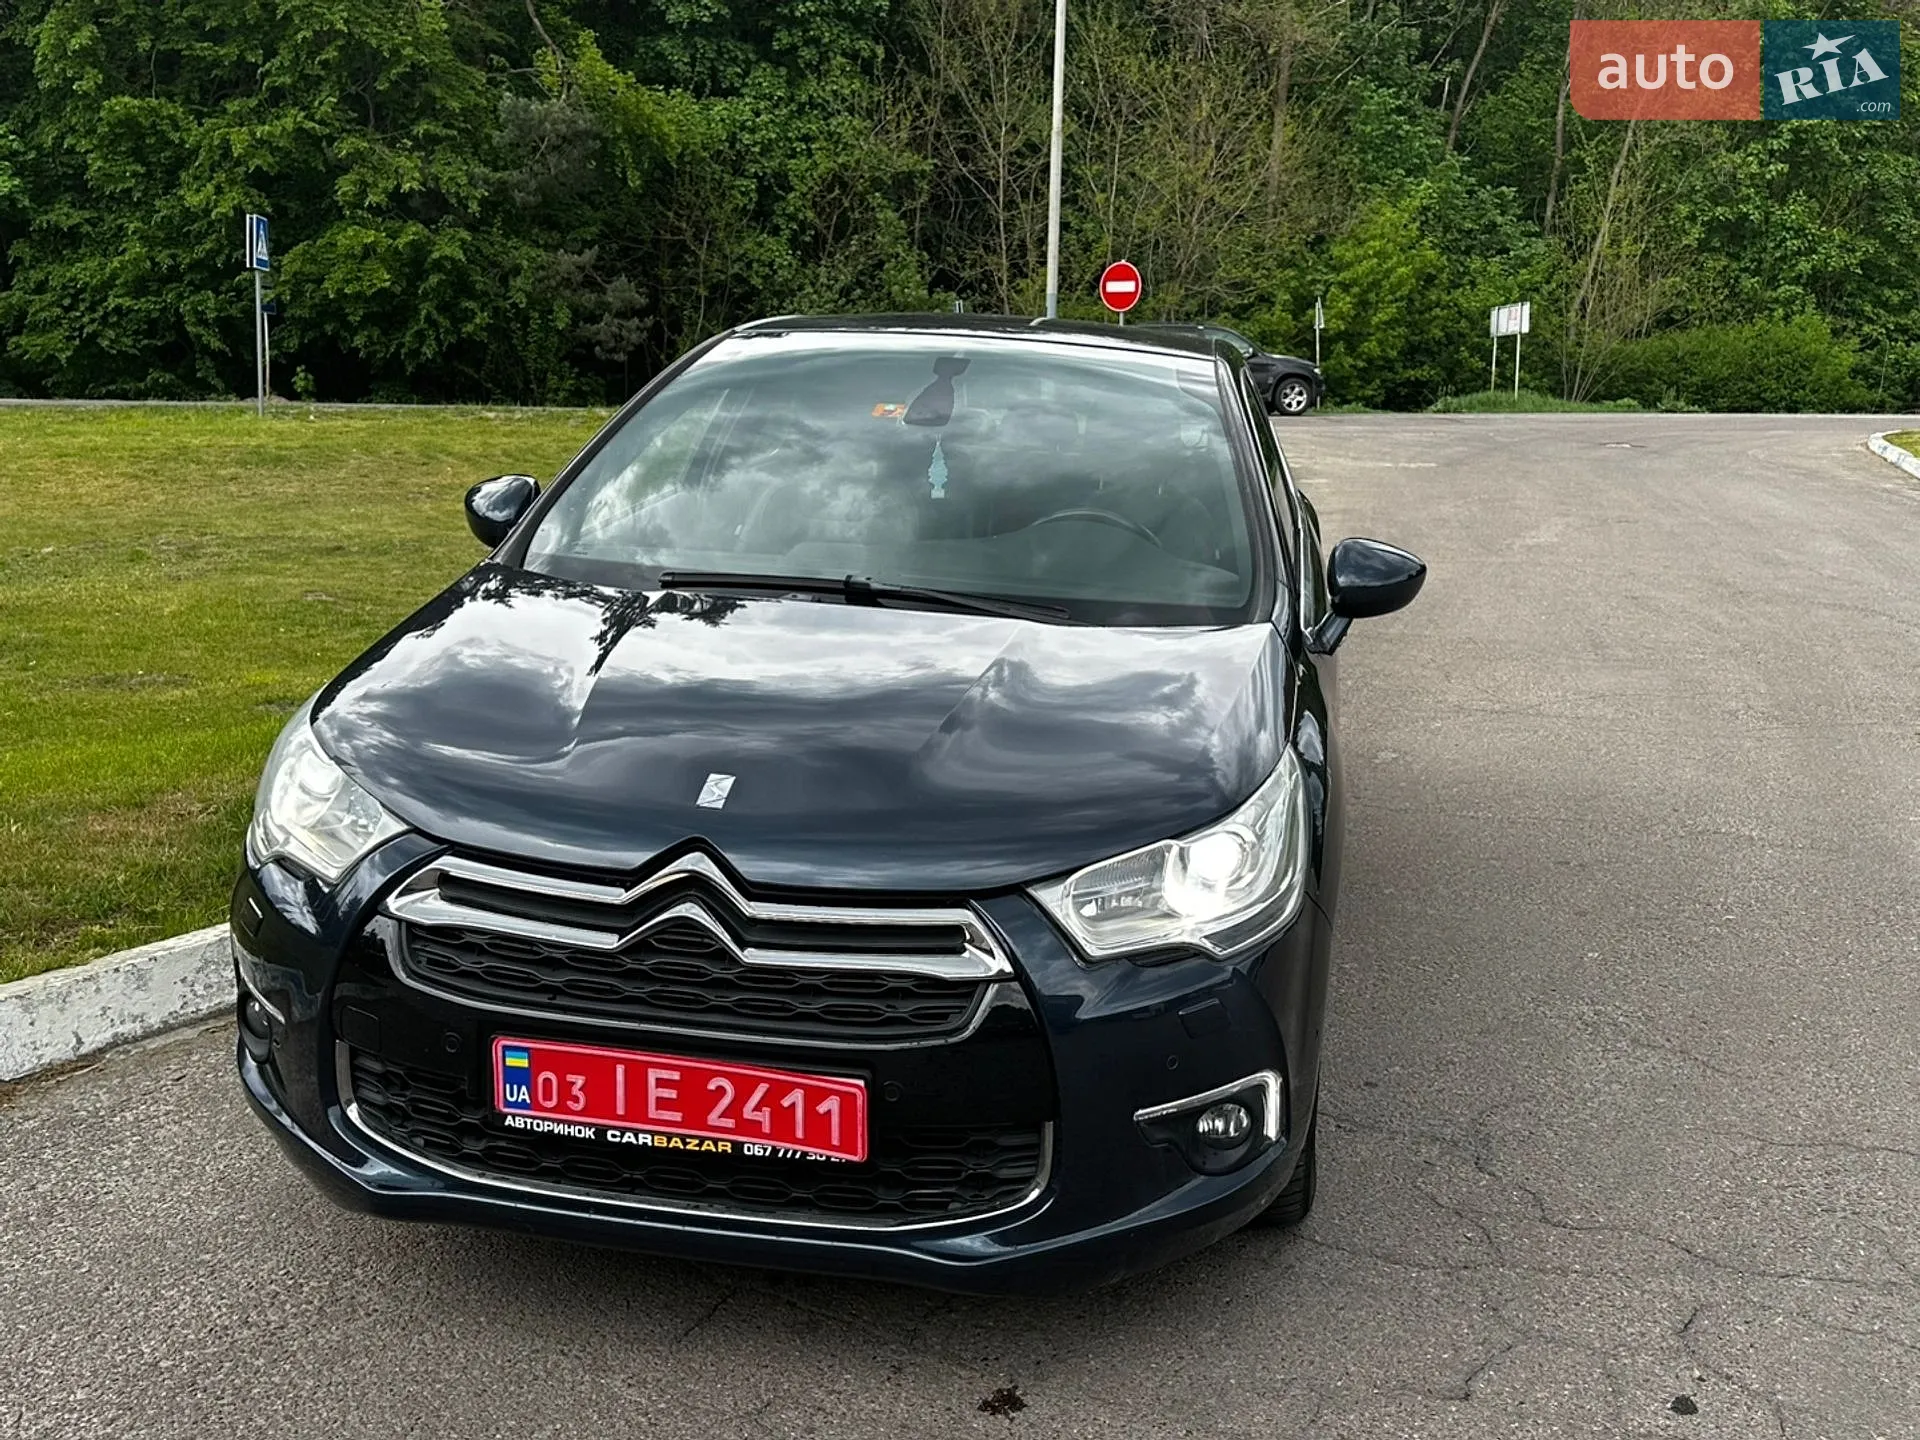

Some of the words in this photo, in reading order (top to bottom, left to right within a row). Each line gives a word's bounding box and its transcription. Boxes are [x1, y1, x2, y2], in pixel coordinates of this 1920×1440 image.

[505, 1083, 531, 1104] UA
[537, 1070, 587, 1112] 03
[615, 1063, 682, 1122] IE
[706, 1076, 841, 1147] 2411
[504, 1115, 596, 1140] АВТОРИНОК
[606, 1129, 732, 1154] CARBAZAR
[743, 1142, 772, 1157] 067
